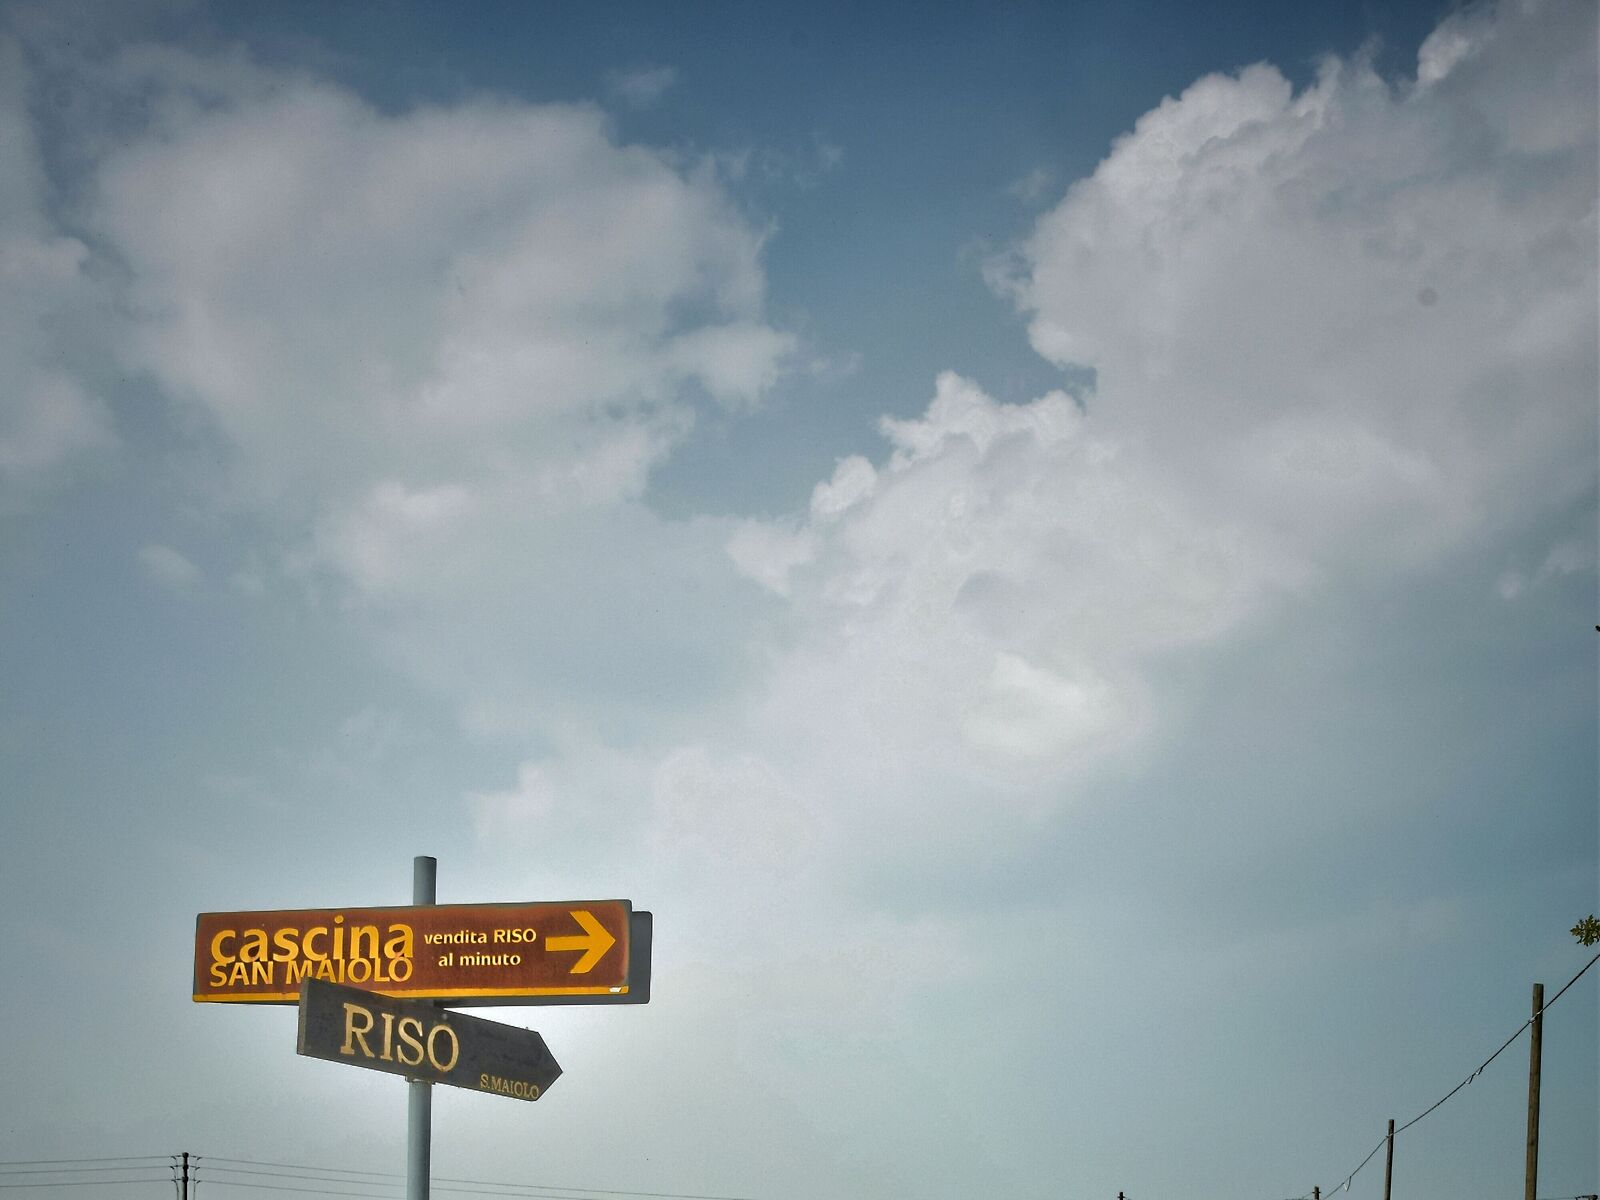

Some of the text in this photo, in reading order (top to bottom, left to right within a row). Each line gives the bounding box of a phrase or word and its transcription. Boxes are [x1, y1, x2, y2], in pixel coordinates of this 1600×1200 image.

[210, 915, 414, 963] cascina
[424, 928, 537, 945] vendita RISO
[209, 956, 414, 988] SAN MAIOLO
[438, 952, 521, 967] al minuto
[340, 1002, 459, 1073] RISO
[480, 1073, 540, 1099] S.MAIOLO
